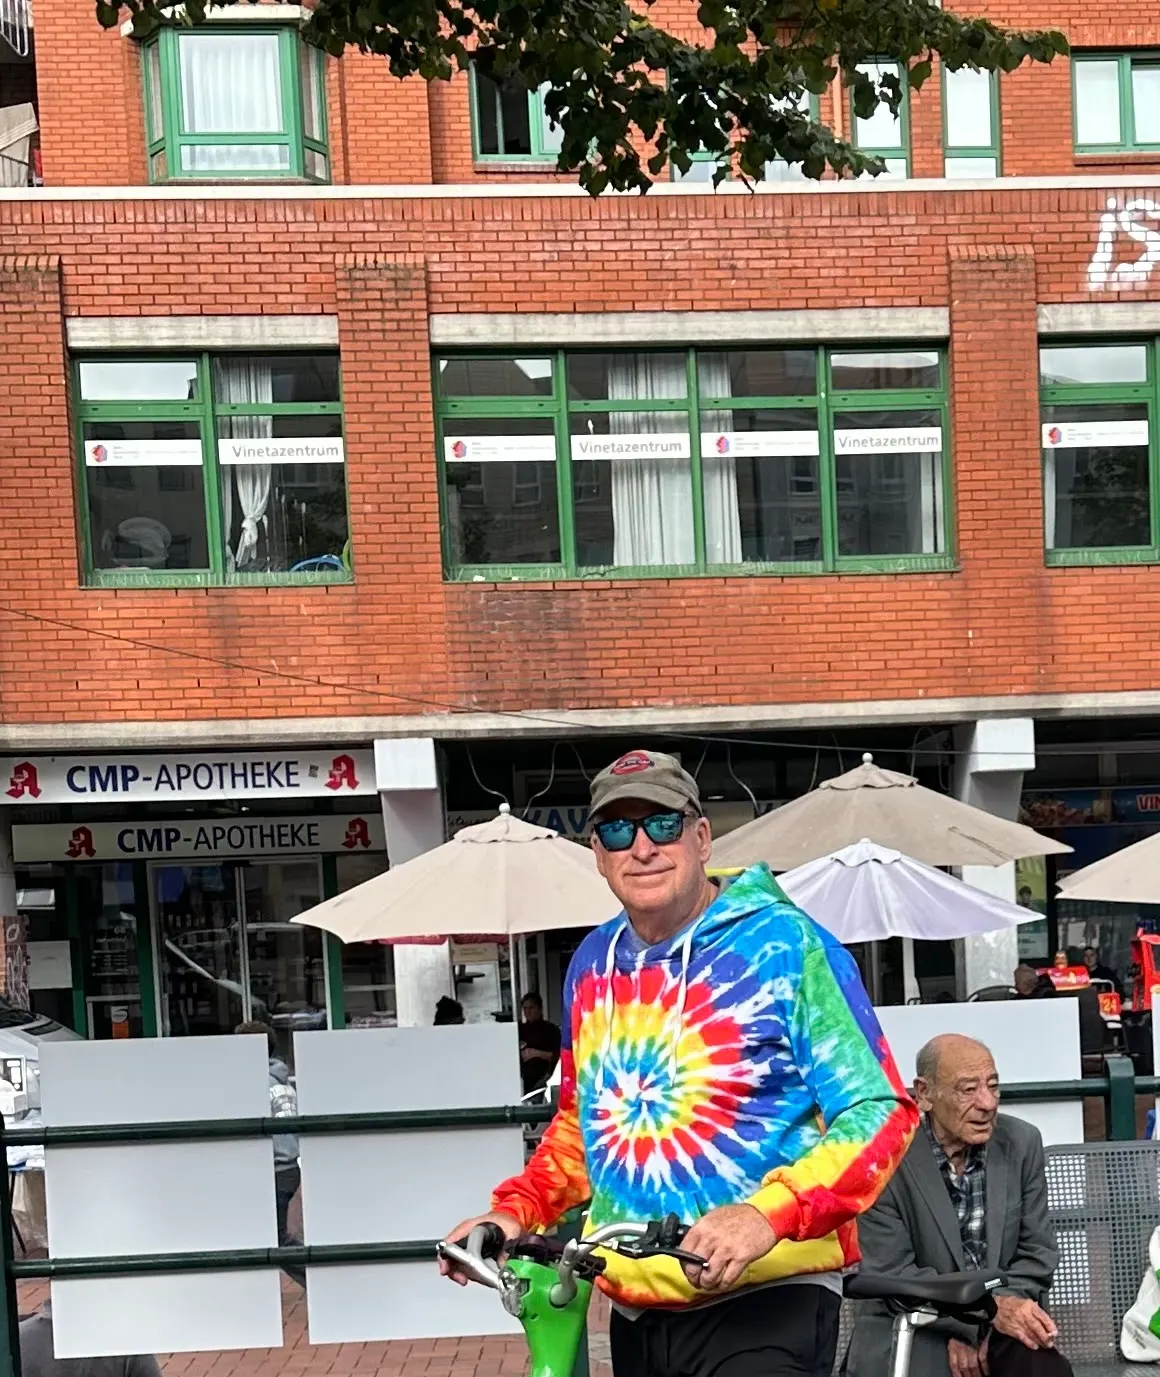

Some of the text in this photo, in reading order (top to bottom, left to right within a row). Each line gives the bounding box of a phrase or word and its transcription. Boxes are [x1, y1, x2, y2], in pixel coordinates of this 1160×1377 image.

[579, 439, 682, 455] Vinetazentrum
[839, 434, 939, 449] Vinetazentrum
[232, 445, 339, 459] Vinetazentrum
[66, 760, 300, 793] CMP-APOTHEKE
[117, 822, 320, 853] CMP-APOTHEKE
